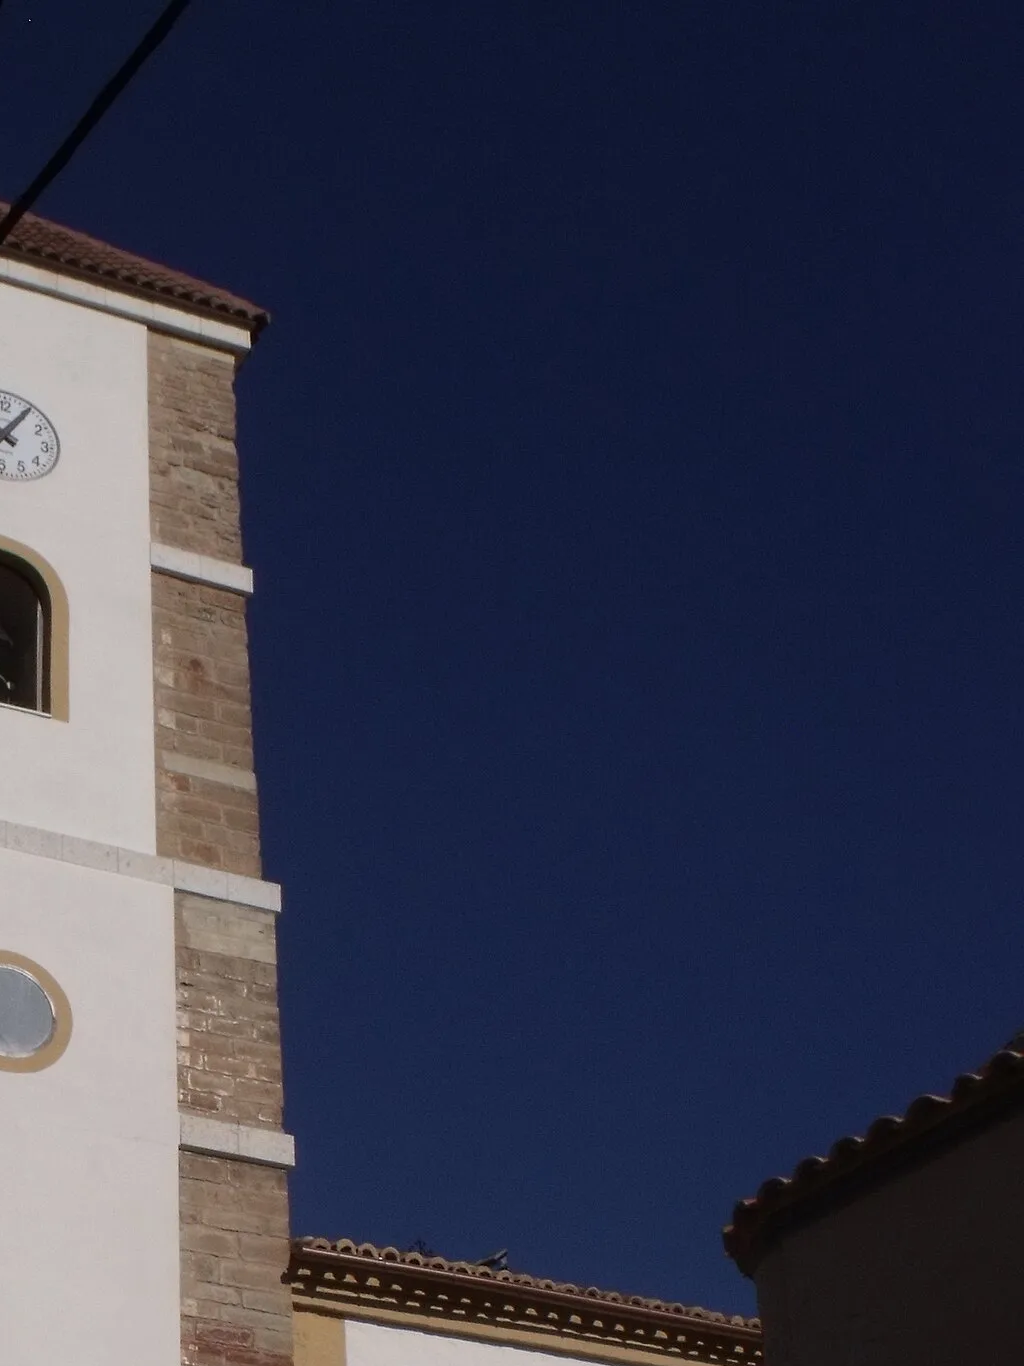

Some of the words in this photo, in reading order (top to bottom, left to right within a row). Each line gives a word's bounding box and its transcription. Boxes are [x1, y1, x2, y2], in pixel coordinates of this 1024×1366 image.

[0, 400, 11, 413] 12
[34, 424, 43, 436] 2
[40, 441, 49, 453] 3
[17, 460, 26, 472] 5
[31, 456, 40, 467] 4
